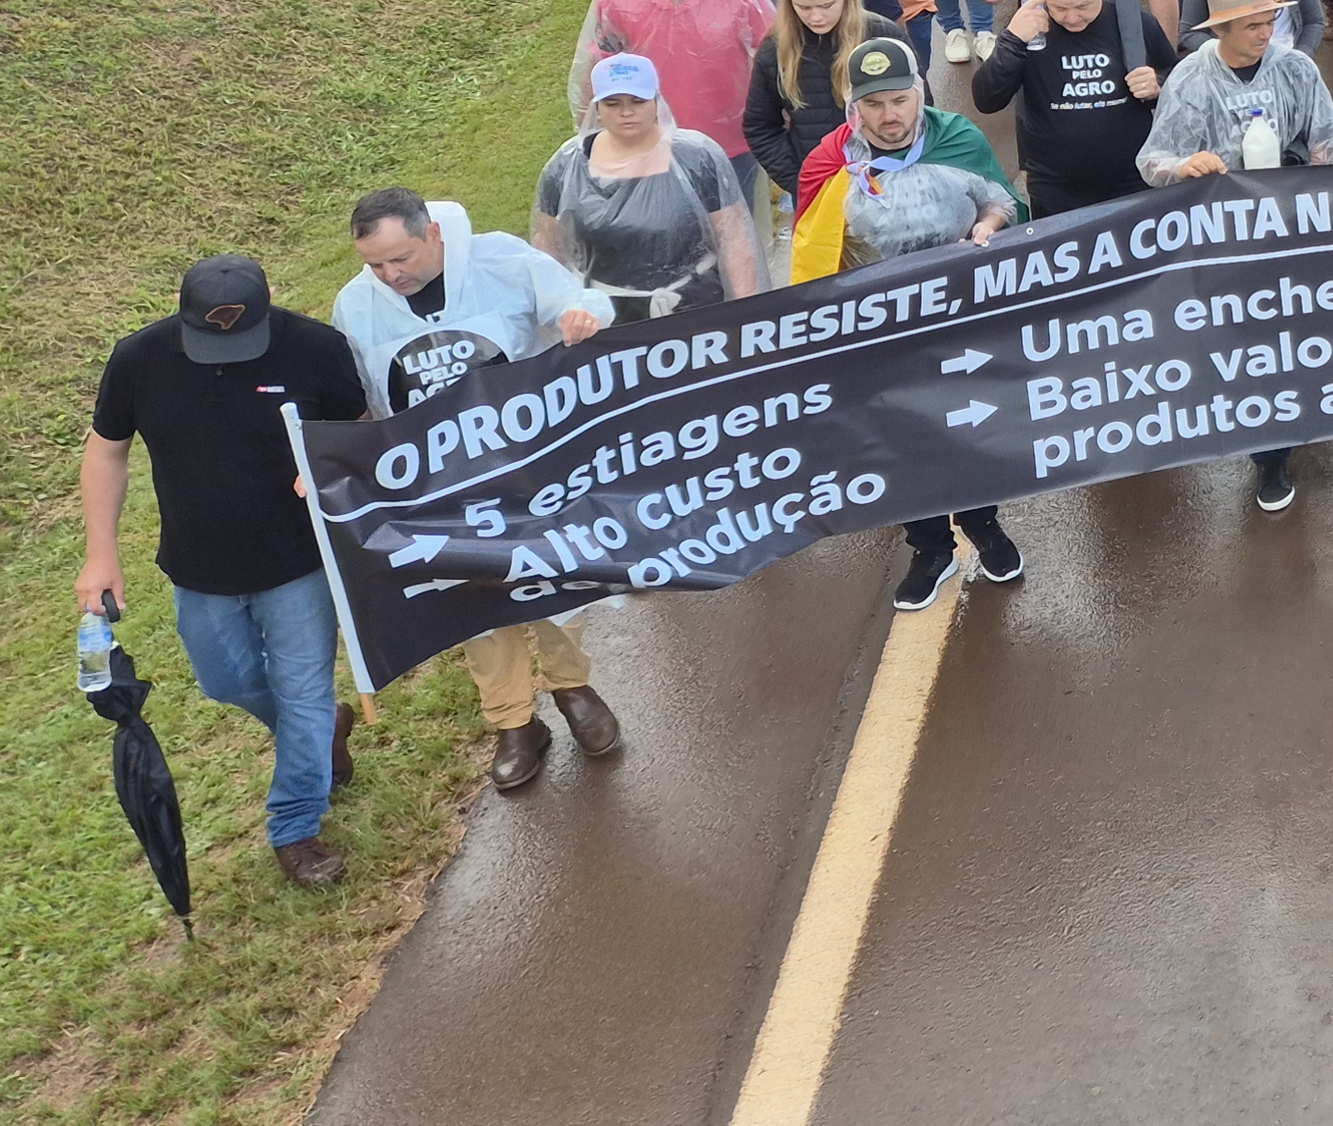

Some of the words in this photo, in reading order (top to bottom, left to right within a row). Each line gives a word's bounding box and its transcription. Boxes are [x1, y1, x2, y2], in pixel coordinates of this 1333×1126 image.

[1061, 53, 1110, 70] LUTO
[1062, 79, 1116, 97] AGRO
[1072, 68, 1103, 80] PELO
[1225, 89, 1273, 110] LUTO
[374, 442, 421, 491] O
[426, 330, 729, 475] PRODUTOR
[740, 277, 963, 358] RESISTE,
[973, 240, 1080, 305] MAS
[1087, 231, 1123, 275] A
[1129, 196, 1289, 260] CONTA
[402, 340, 475, 375] LUTO
[1020, 306, 1154, 363] Uma
[419, 361, 468, 385] PELO
[1026, 358, 1192, 422] Baixo
[464, 498, 508, 539] 5
[527, 382, 834, 517] estiagens
[1032, 388, 1302, 480] produtos
[502, 515, 629, 584] Alto
[635, 446, 802, 531] custo
[627, 470, 887, 590] produção
